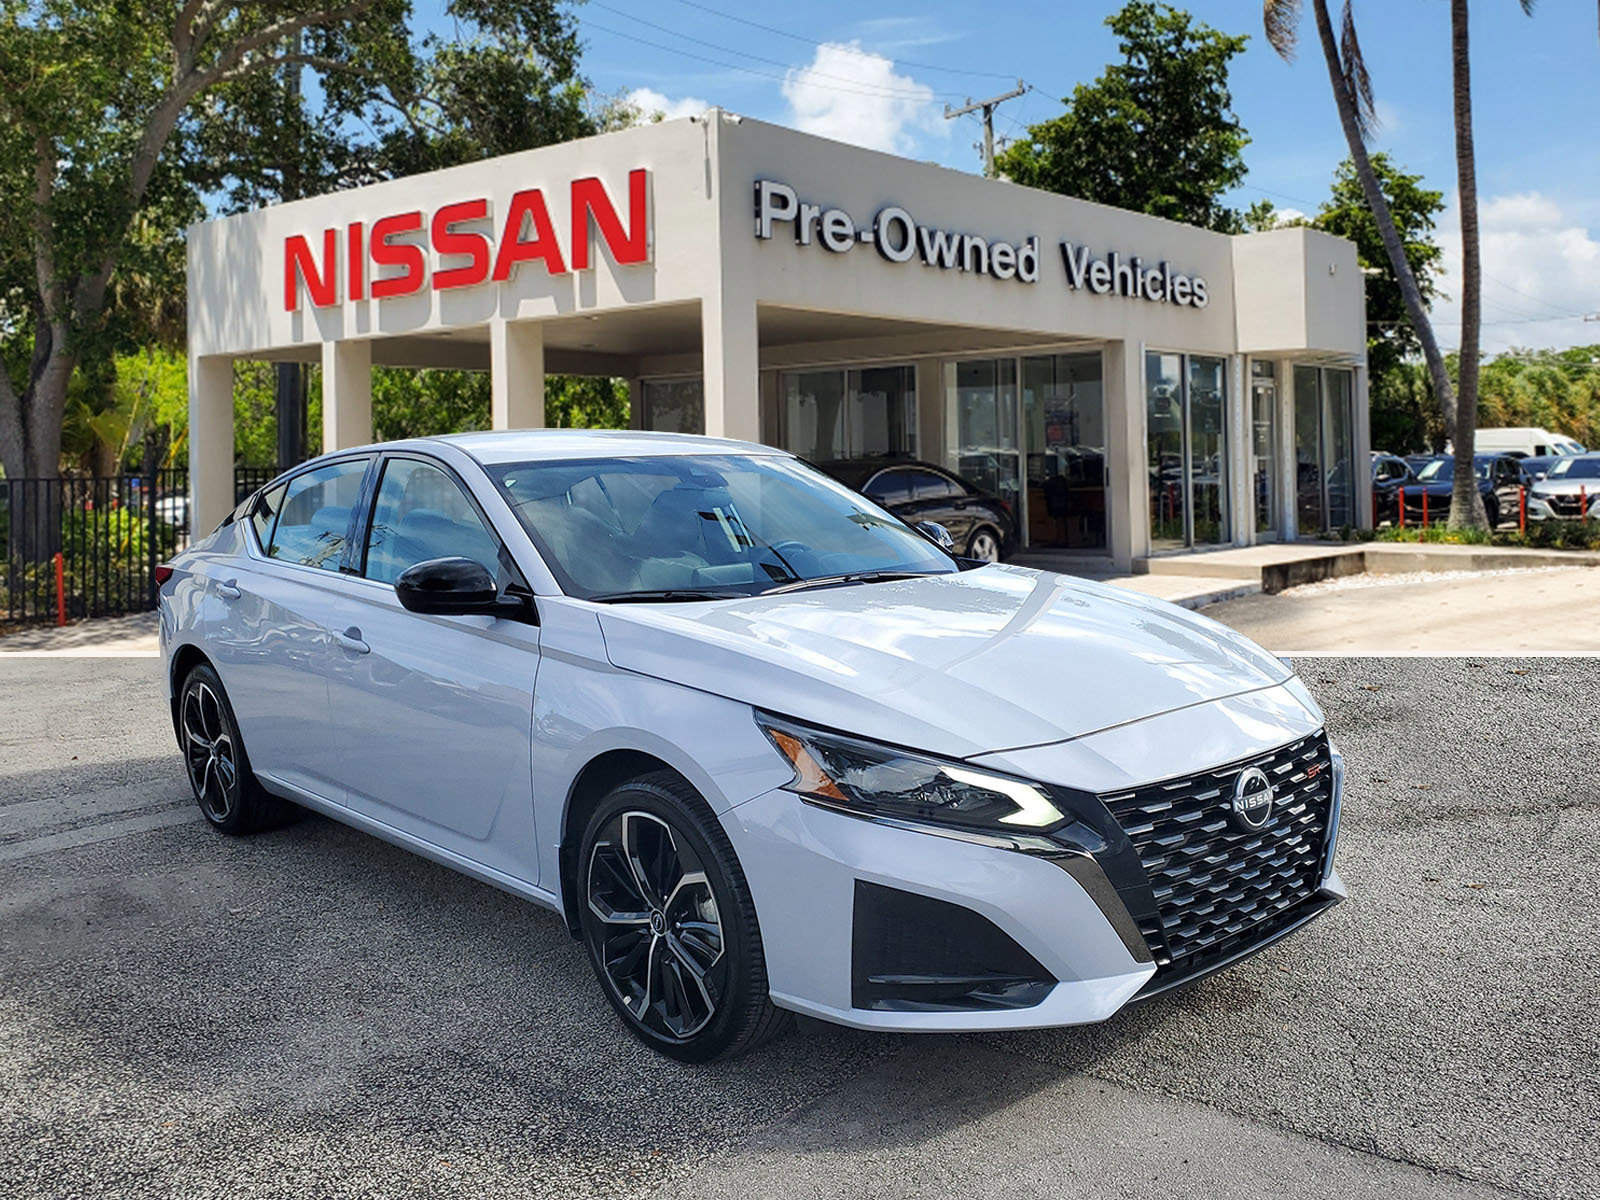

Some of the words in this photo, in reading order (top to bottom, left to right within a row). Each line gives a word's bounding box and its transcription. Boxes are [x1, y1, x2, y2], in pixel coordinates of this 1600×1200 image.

[284, 167, 648, 312] NISSAN
[754, 179, 1041, 284] Pre-Owned
[1060, 240, 1209, 308] Vehicles
[1307, 763, 1321, 779] SR
